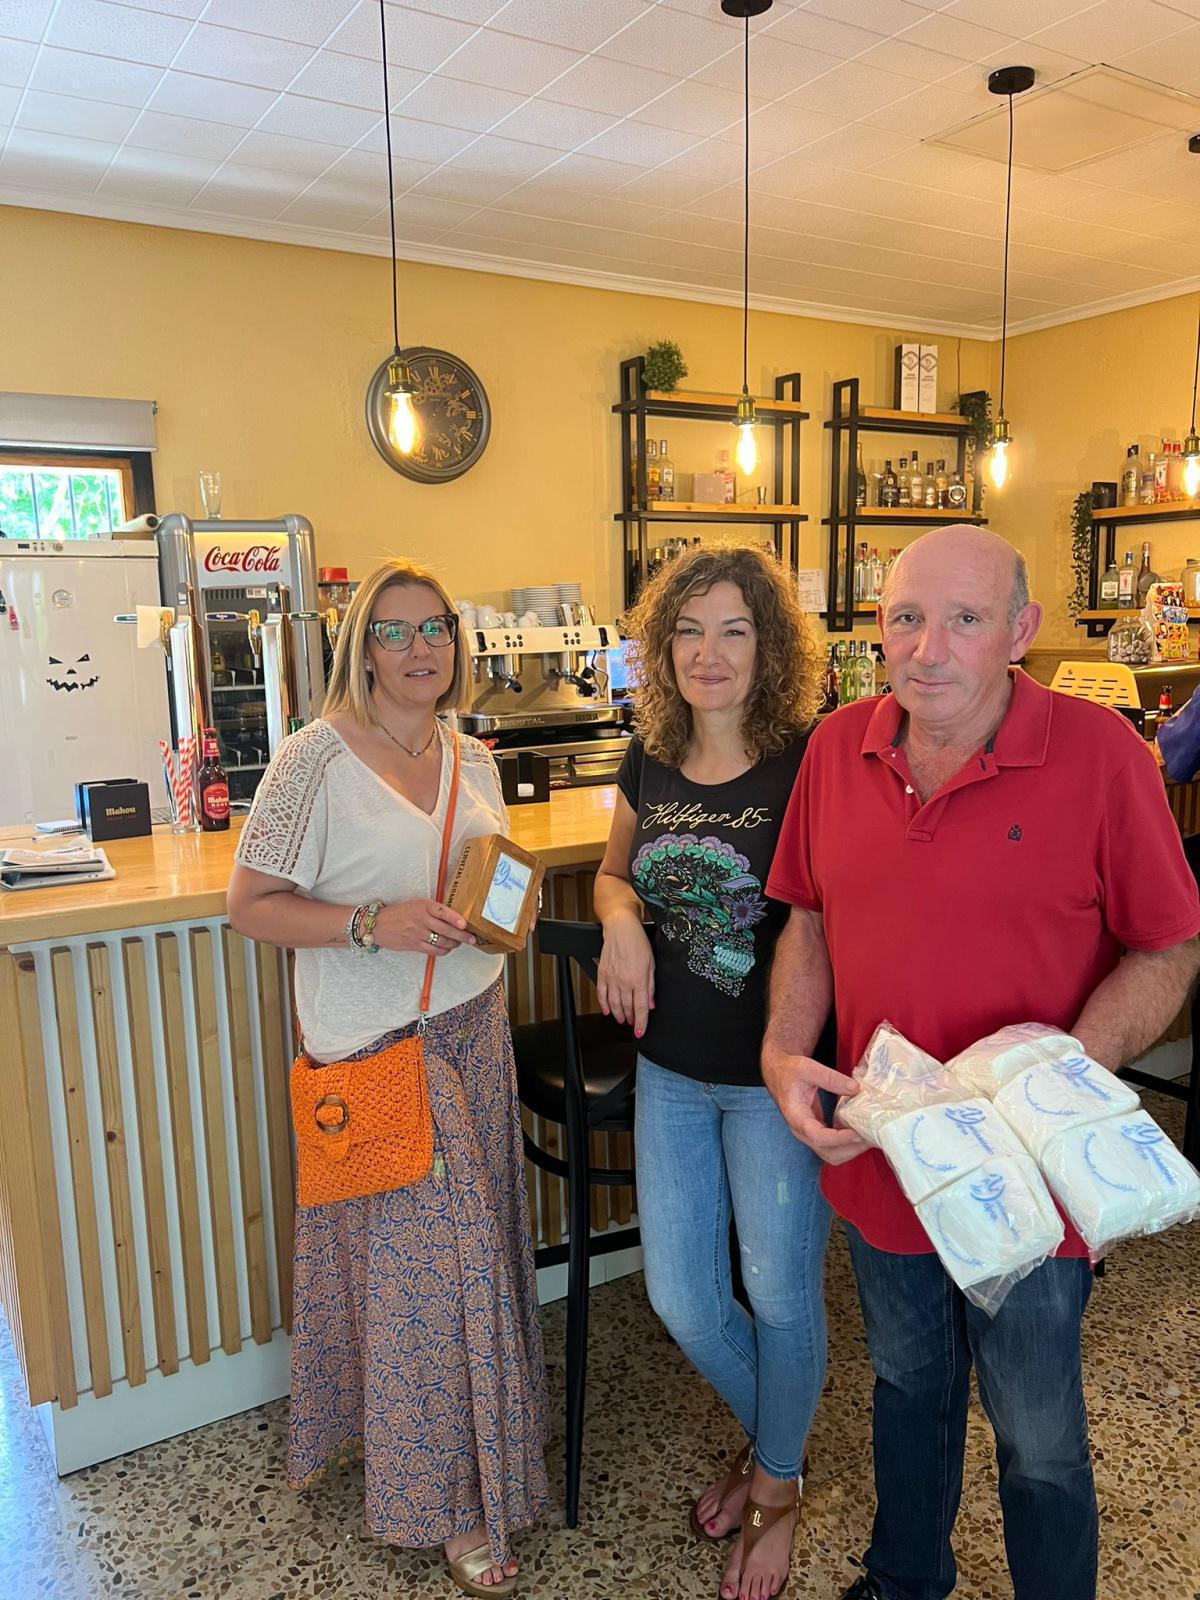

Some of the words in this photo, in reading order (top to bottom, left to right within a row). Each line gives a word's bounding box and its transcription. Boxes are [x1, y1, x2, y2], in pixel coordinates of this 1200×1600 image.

[204, 545, 281, 573] Coca-Cola
[105, 806, 137, 817] Mahou
[641, 801, 731, 831] Hilfiger
[723, 807, 772, 828] 85
